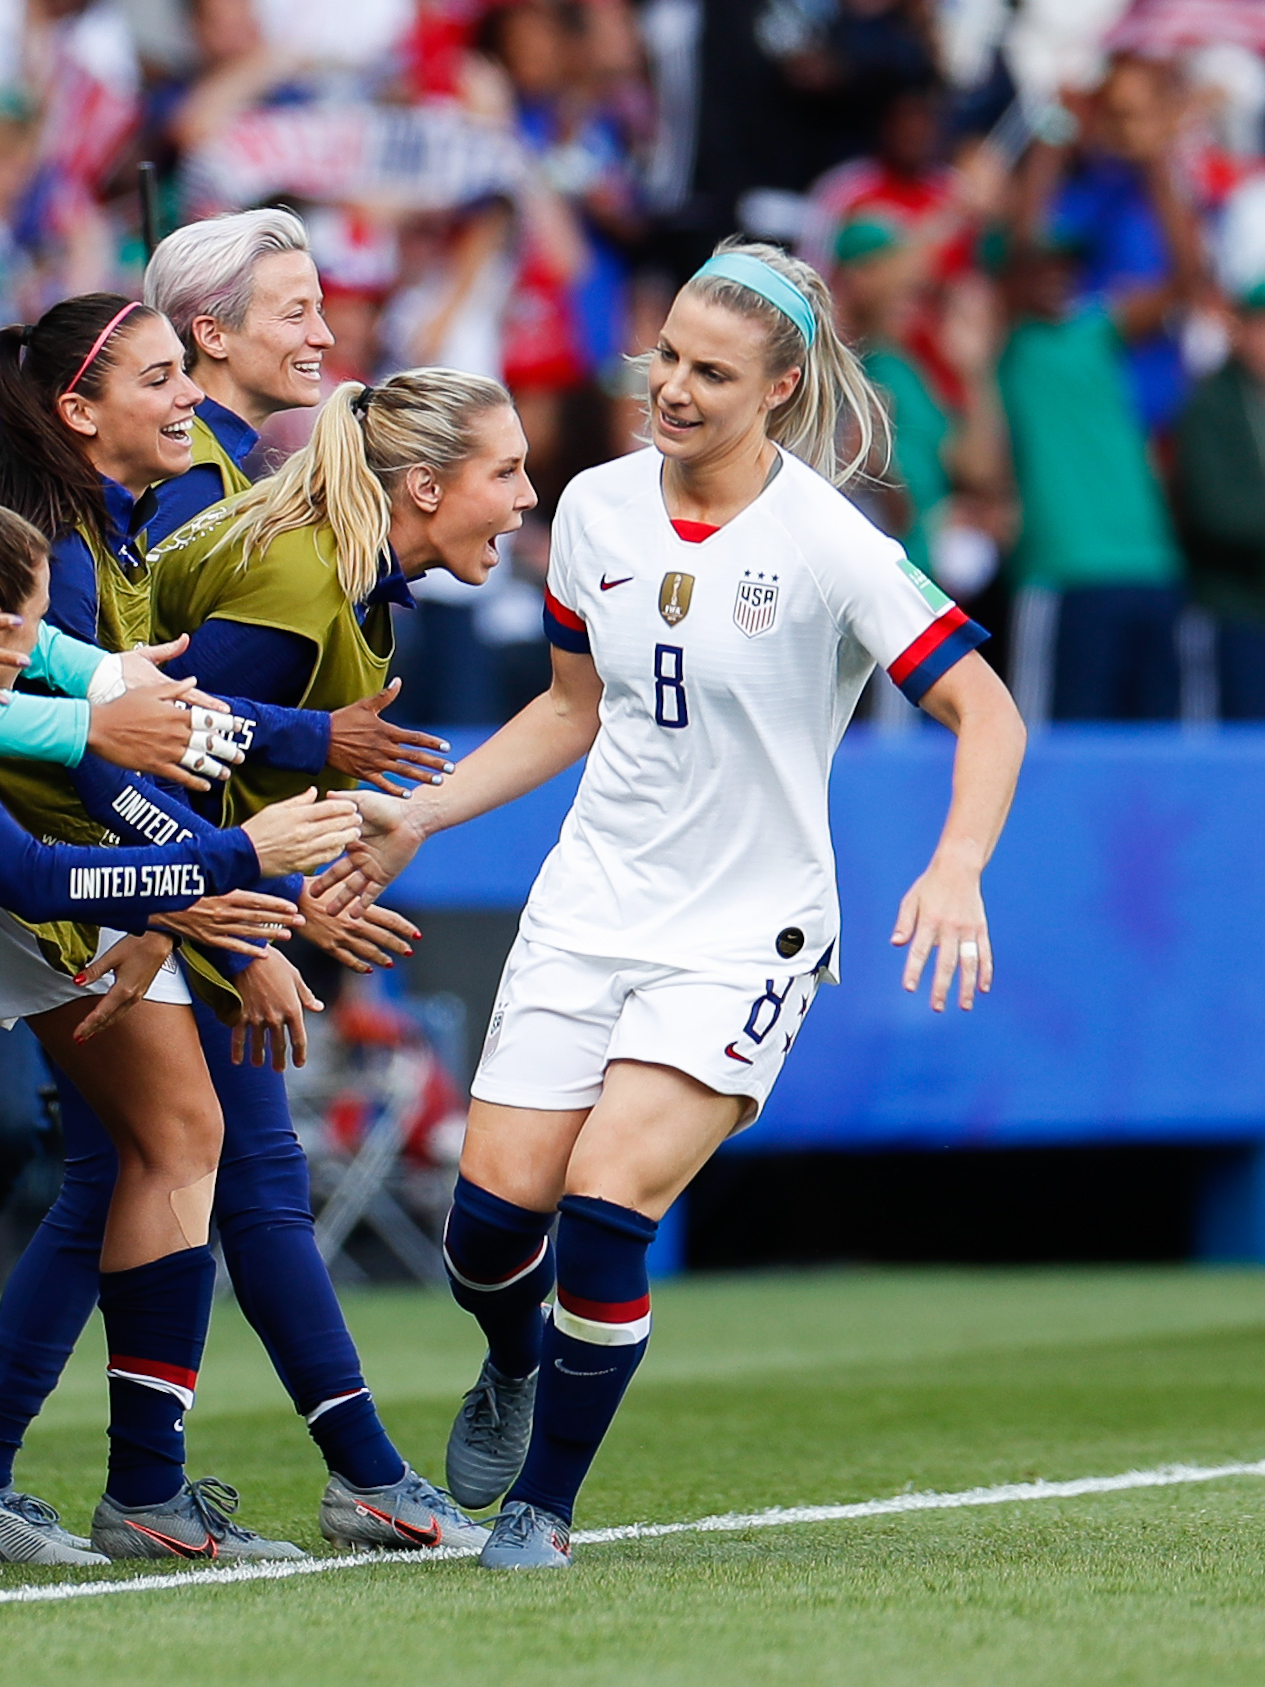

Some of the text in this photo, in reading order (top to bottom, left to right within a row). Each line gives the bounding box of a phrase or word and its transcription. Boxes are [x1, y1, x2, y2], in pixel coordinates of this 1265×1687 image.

[741, 585, 774, 607] USA
[654, 643, 689, 729] 8
[112, 785, 179, 846] UNITED
[70, 864, 205, 899] UNITED STATES
[743, 976, 795, 1044] 8
